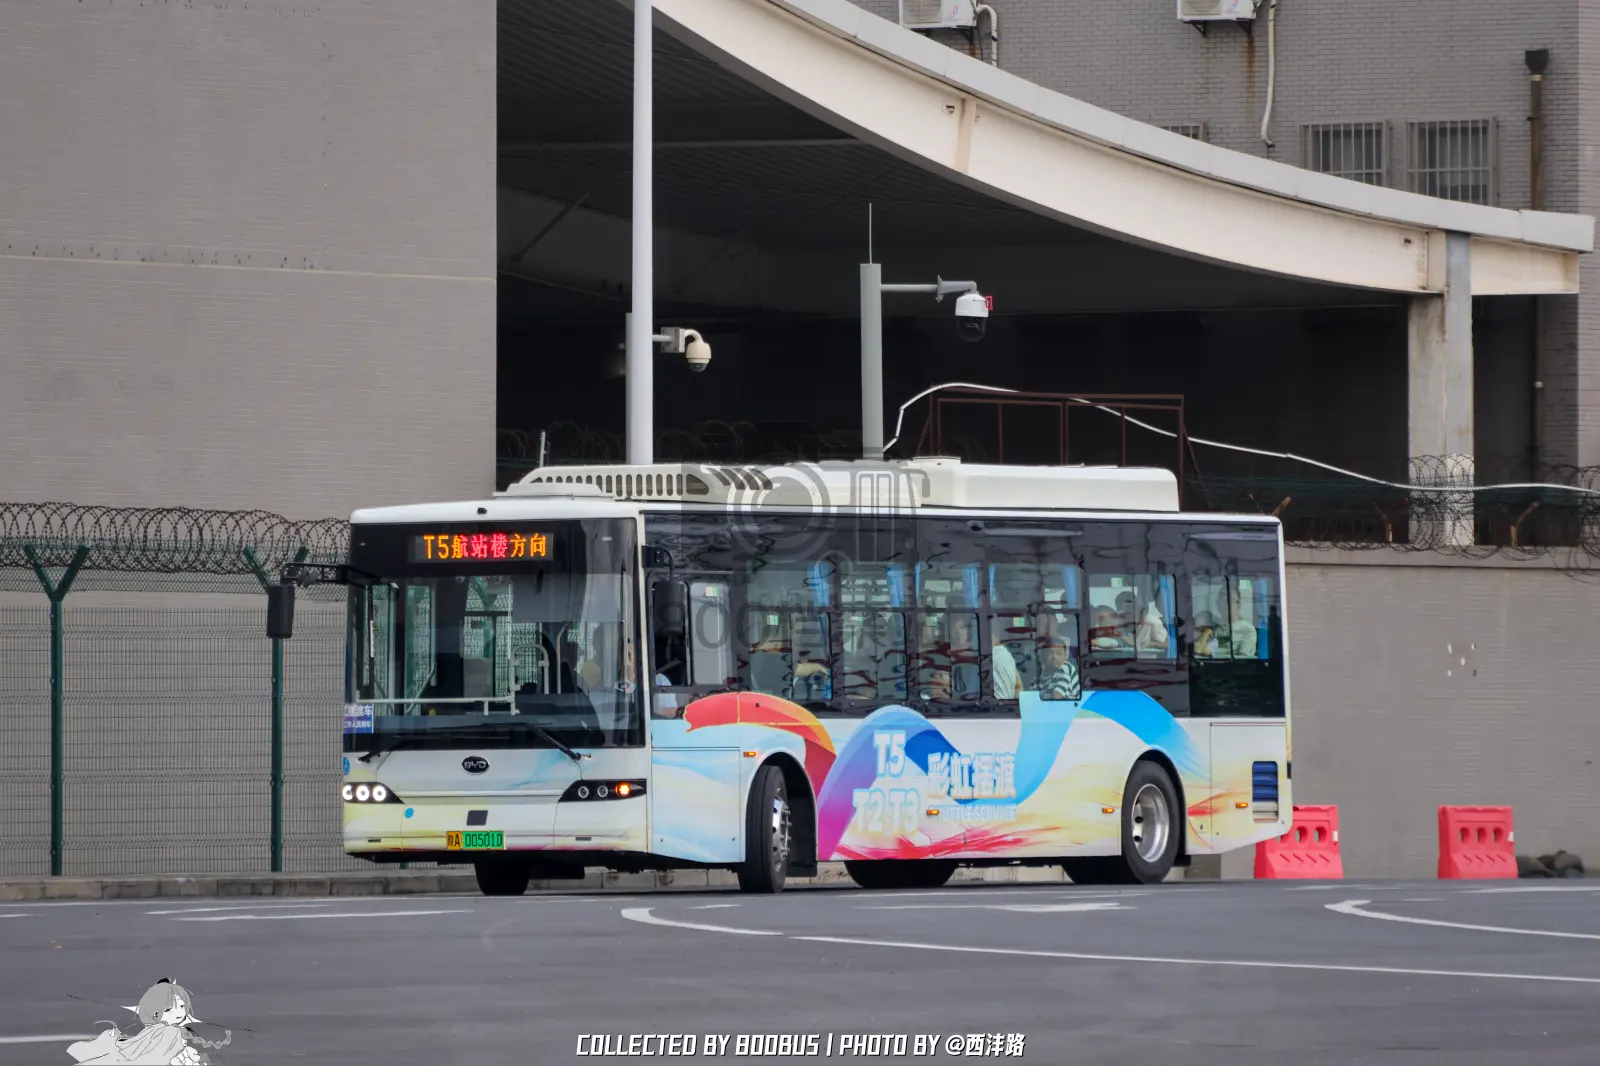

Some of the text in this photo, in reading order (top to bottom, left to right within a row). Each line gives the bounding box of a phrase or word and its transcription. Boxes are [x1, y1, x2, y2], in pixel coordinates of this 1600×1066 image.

[423, 533, 547, 559] T5航站楼方向
[463, 760, 488, 770] BYD
[874, 730, 906, 778] T5
[927, 752, 1017, 799] 彩虹摆渡
[853, 788, 921, 834] T2 T3
[972, 804, 1017, 821] SERVICE
